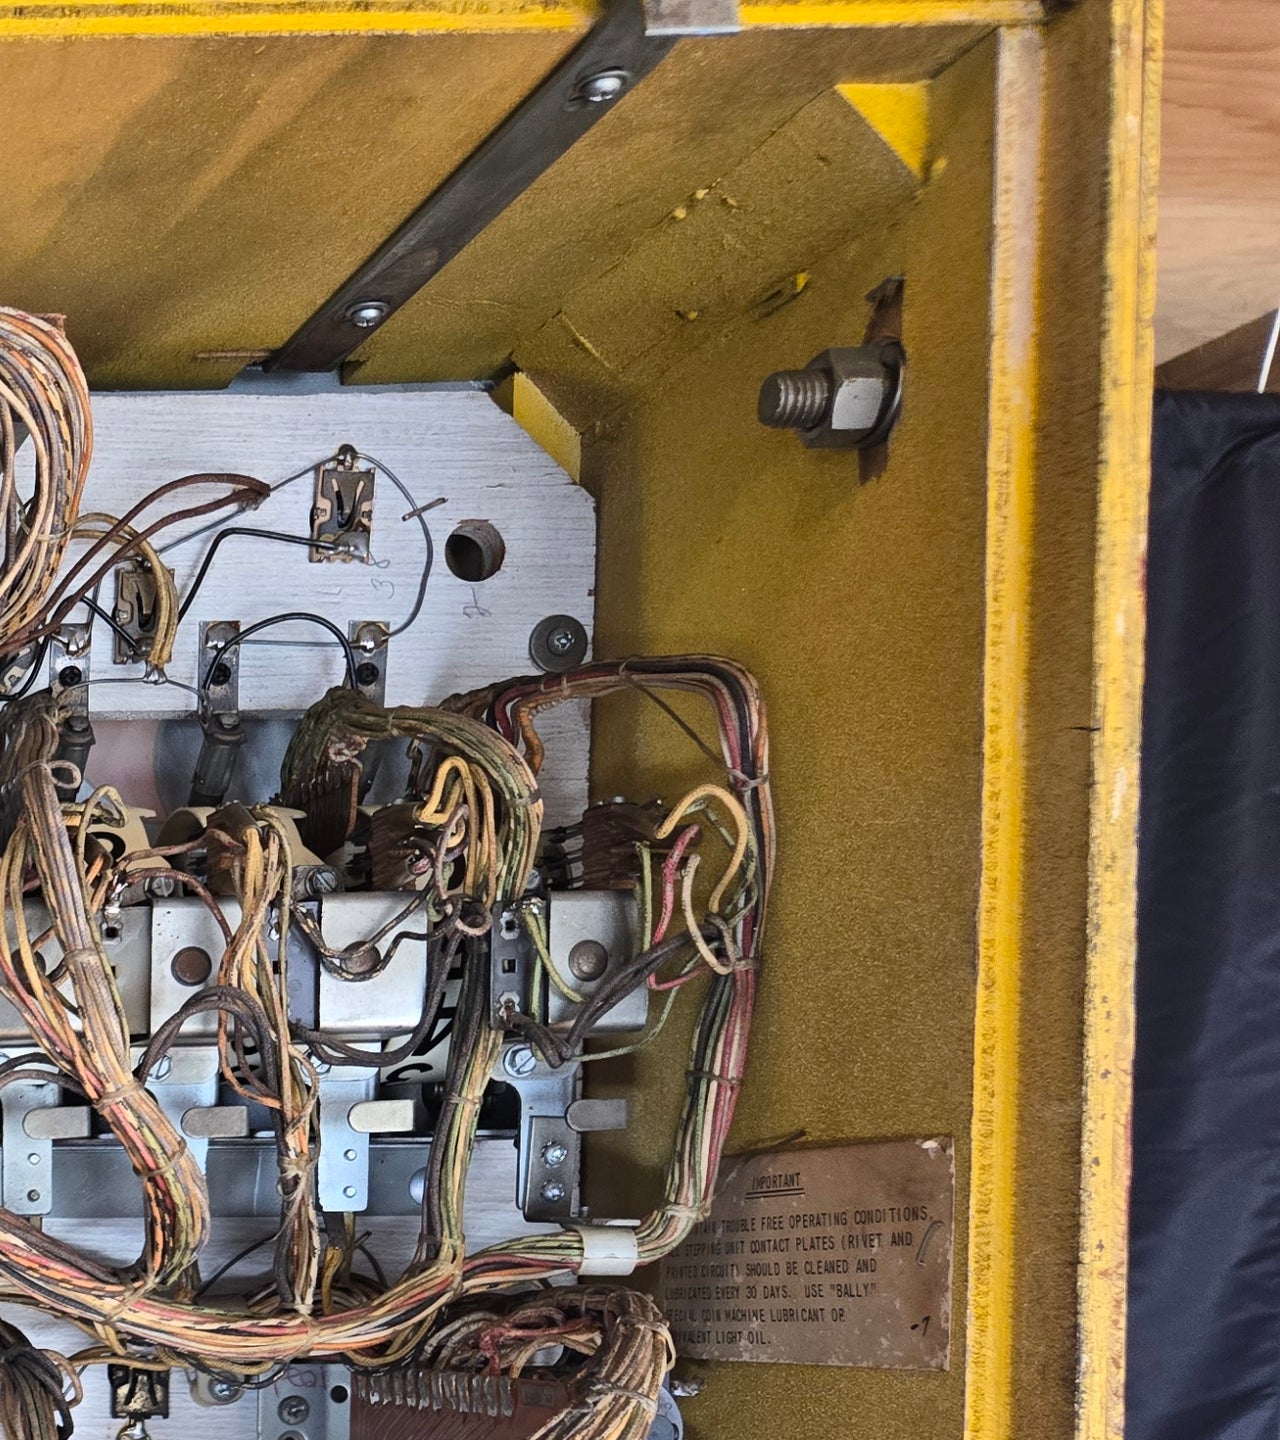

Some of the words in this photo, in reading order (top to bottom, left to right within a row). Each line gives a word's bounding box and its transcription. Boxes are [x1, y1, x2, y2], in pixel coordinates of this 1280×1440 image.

[751, 1173, 801, 1190] IMPORTANT
[721, 1218, 755, 1233] TROUBLE
[761, 1216, 784, 1230] FREE
[789, 1212, 847, 1230] OPERATING
[686, 1241, 723, 1257] STEPPING
[726, 1240, 745, 1255] UNIT
[750, 1238, 790, 1254] CONTACT
[795, 1236, 835, 1251] PLATES
[841, 1232, 882, 1250] (RIVET
[891, 1231, 913, 1247] AND
[666, 1264, 697, 1279] PRINTED
[746, 1262, 780, 1278] SHOULD
[786, 1261, 798, 1276] BE
[804, 1260, 849, 1275] CLEANED
[856, 1258, 877, 1273] AND
[665, 1285, 711, 1300] LUBRICATED
[716, 1285, 740, 1300] EVERY
[746, 1285, 757, 1299] 30
[763, 1285, 792, 1299] DAYS.
[805, 1283, 824, 1298] USE
[830, 1283, 876, 1298] "BALLY"
[701, 1309, 721, 1322] COIN
[725, 1308, 766, 1322] MACHINE
[770, 1308, 825, 1322] LUBRICANT
[831, 1308, 845, 1322] OR
[716, 1331, 742, 1344] LIGHT
[747, 1330, 772, 1344] OIL.
